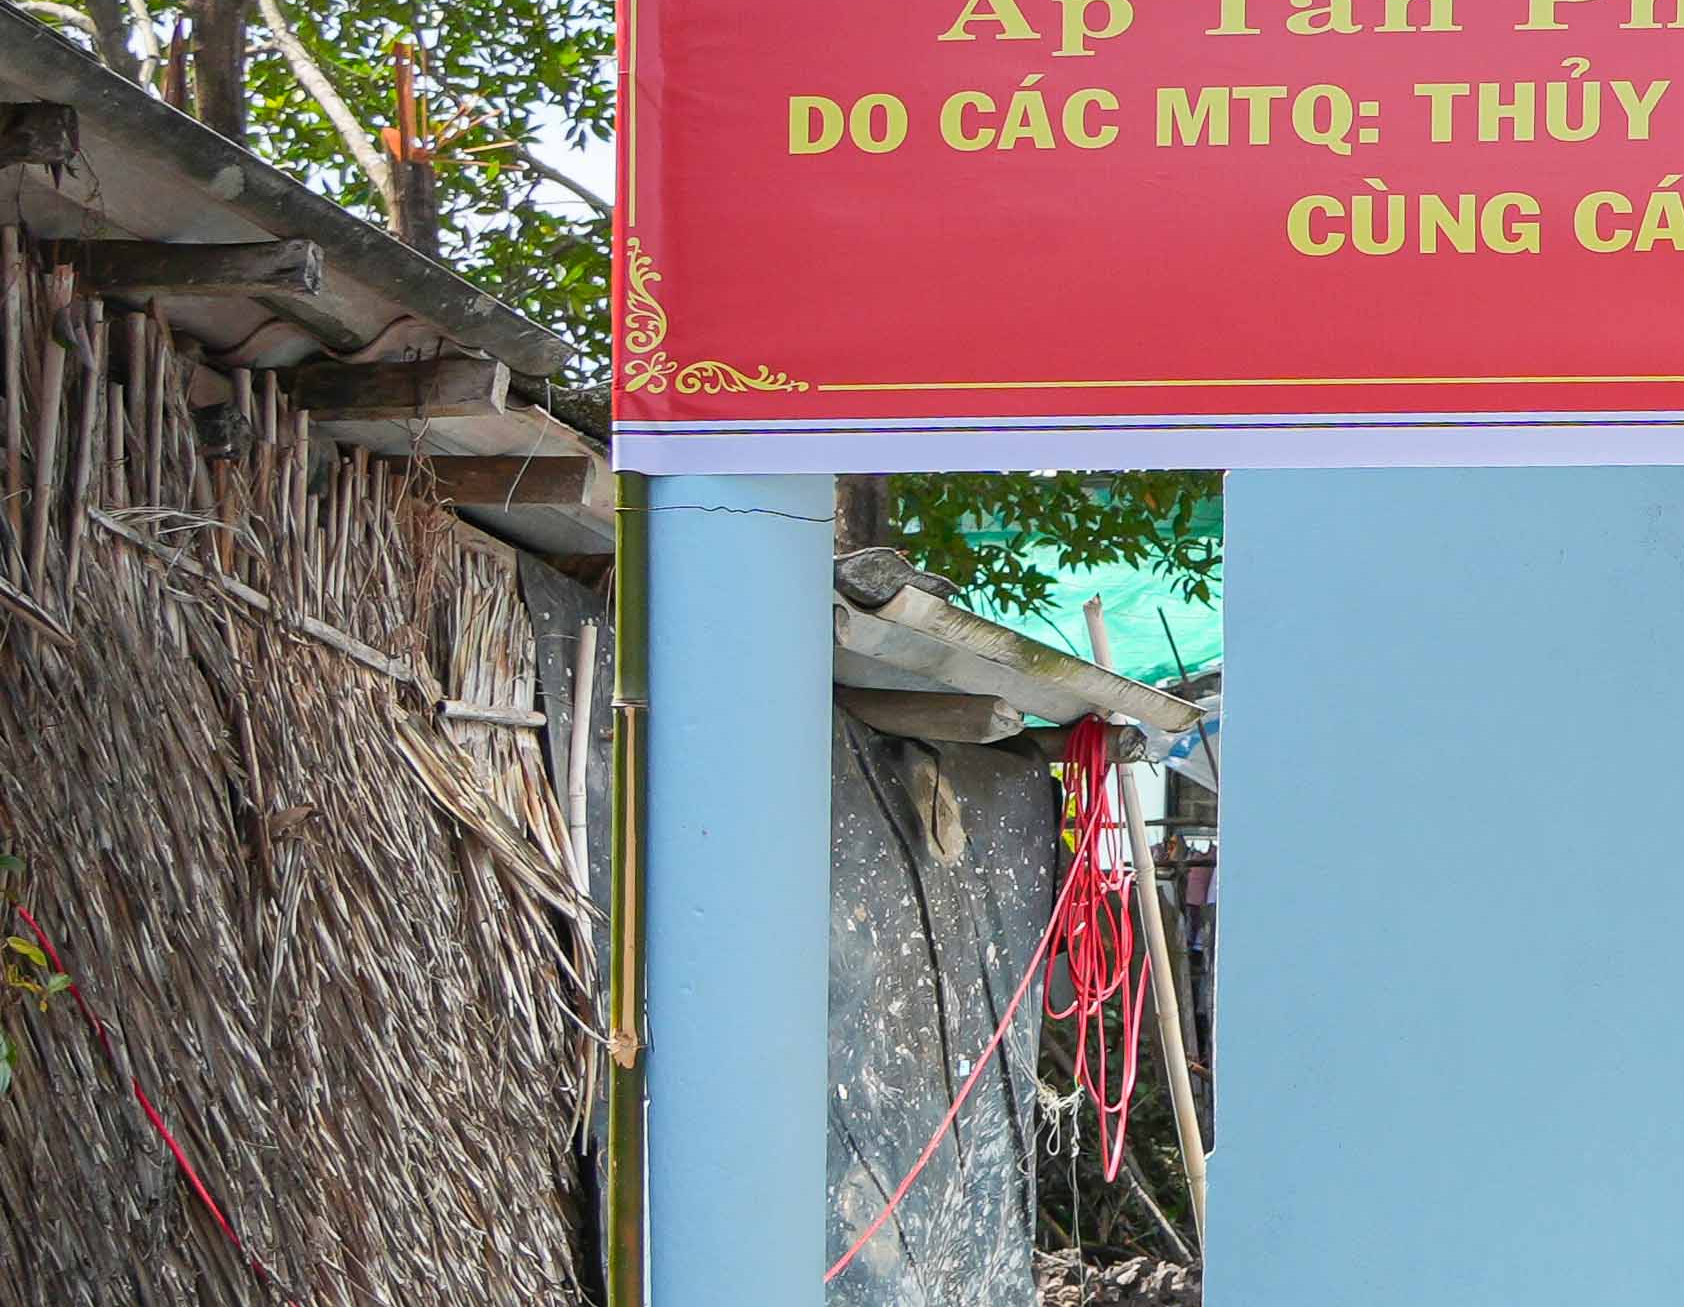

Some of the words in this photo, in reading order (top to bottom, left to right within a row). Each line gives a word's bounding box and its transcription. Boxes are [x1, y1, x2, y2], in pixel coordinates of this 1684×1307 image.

[788, 93, 908, 155] DO
[940, 73, 1120, 152] CÁC
[1156, 83, 1380, 156] MTQ:
[1414, 56, 1669, 143] THỦY
[1286, 178, 1541, 256] CÙNG
